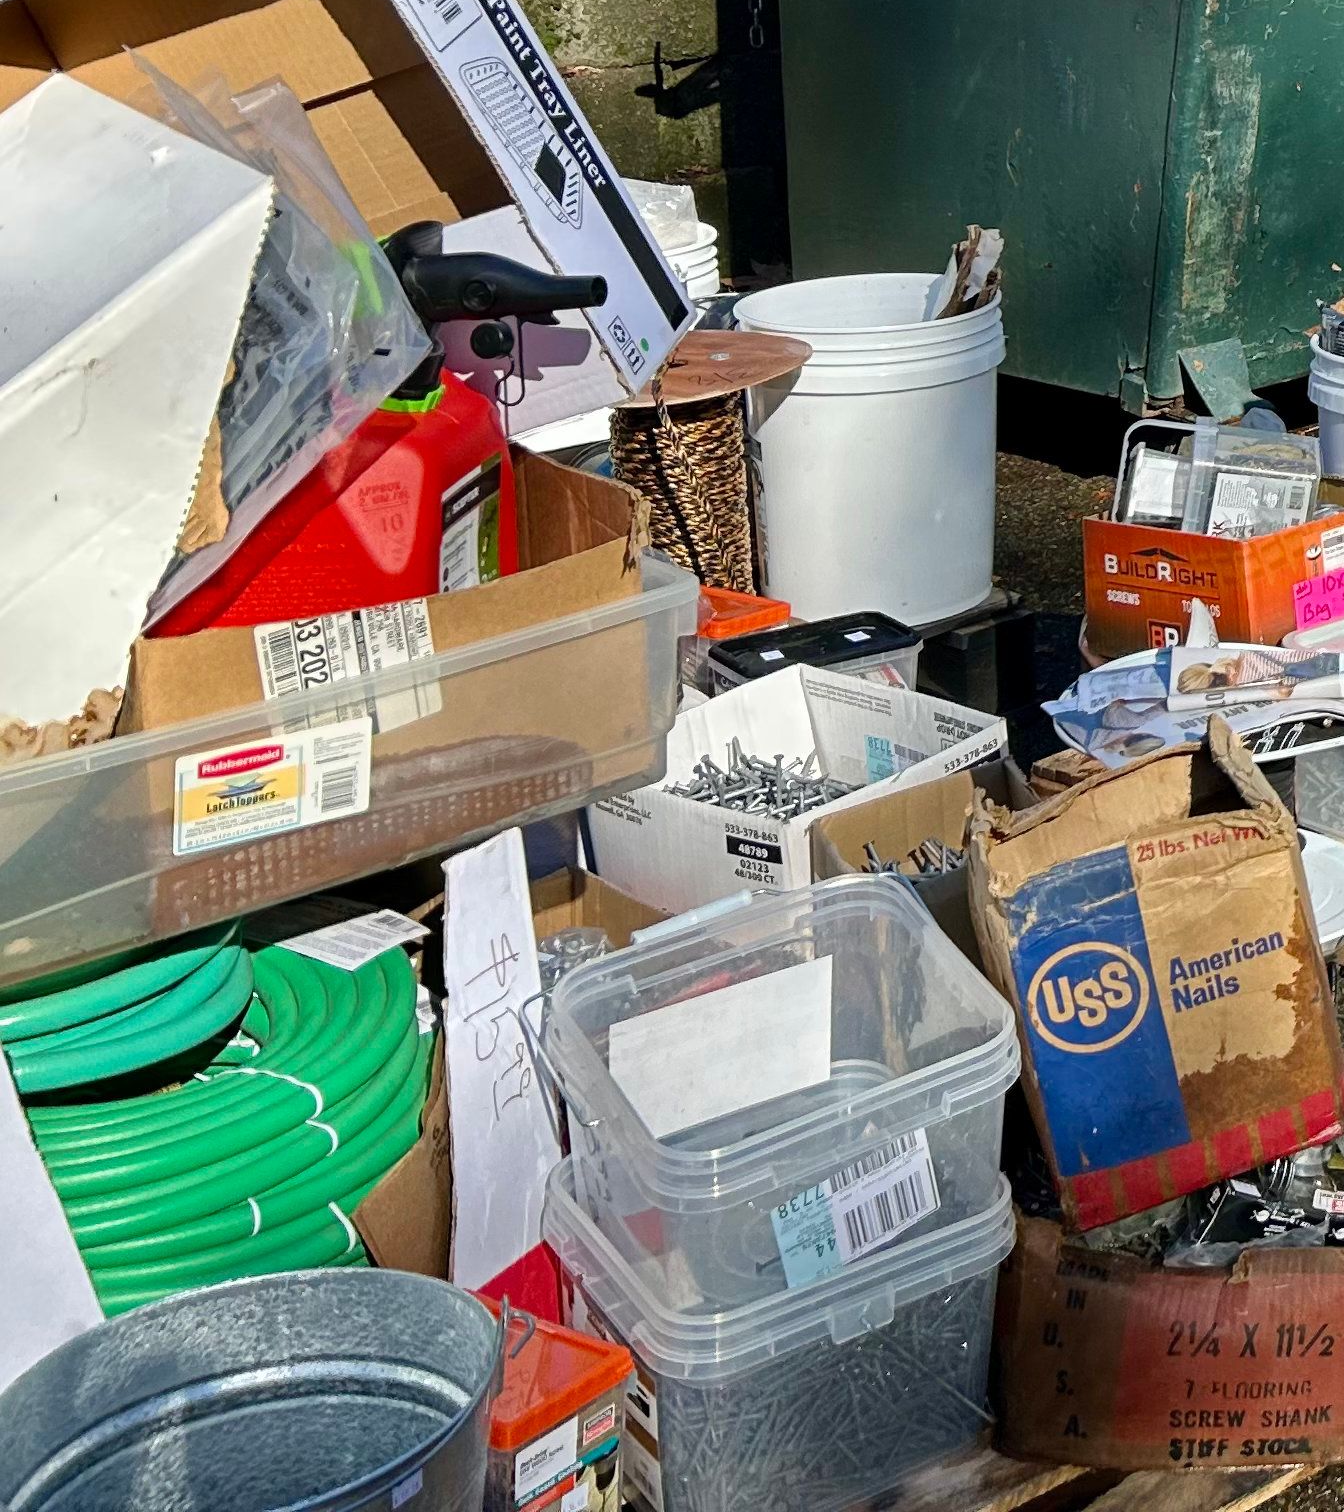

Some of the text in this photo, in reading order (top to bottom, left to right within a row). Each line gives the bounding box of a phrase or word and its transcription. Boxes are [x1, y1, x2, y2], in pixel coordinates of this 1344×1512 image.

[530, 59, 566, 118] Tray
[563, 119, 606, 188] Liner
[201, 748, 280, 775] Rubbermaid
[944, 738, 998, 773] 533-378-863
[725, 822, 778, 844] 533-378-863
[1136, 841, 1155, 863] 25
[1158, 839, 1191, 858] lbs.
[1193, 829, 1228, 850] Net
[738, 843, 769, 859] 48789
[740, 859, 770, 873] 02123
[1170, 931, 1285, 985] American
[1042, 960, 1133, 1028] USS
[1170, 974, 1241, 1013] Nails
[778, 1184, 824, 1219] 7738
[1065, 1289, 1085, 1311] IN
[1043, 1322, 1063, 1348] U.
[1055, 1370, 1074, 1396] S.
[1212, 1380, 1312, 1399] FLOORING
[1063, 1414, 1088, 1438] A.
[1169, 1405, 1332, 1428] SCREW SHANK
